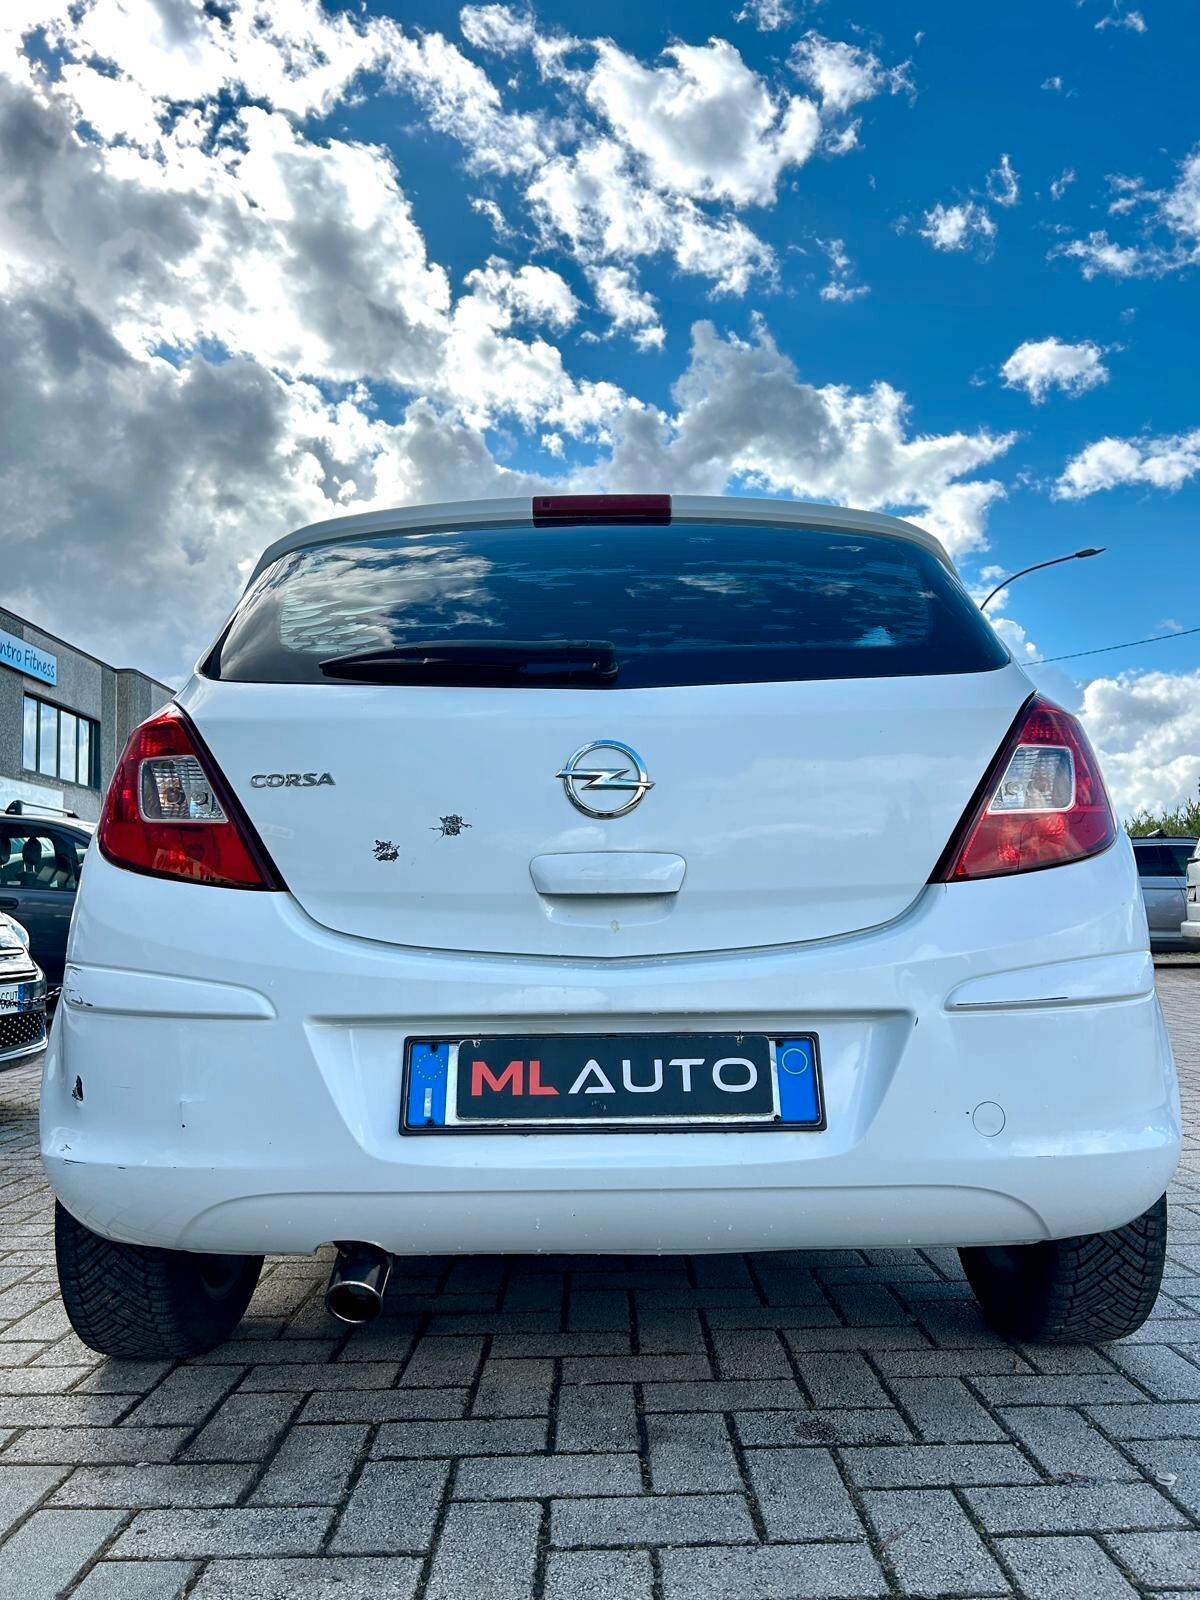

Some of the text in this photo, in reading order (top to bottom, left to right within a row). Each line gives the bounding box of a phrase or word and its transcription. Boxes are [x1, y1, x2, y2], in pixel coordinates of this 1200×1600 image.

[25, 649, 55, 678] Fitness
[250, 772, 336, 788] CORSA
[471, 1057, 758, 1096] ML AUTO
